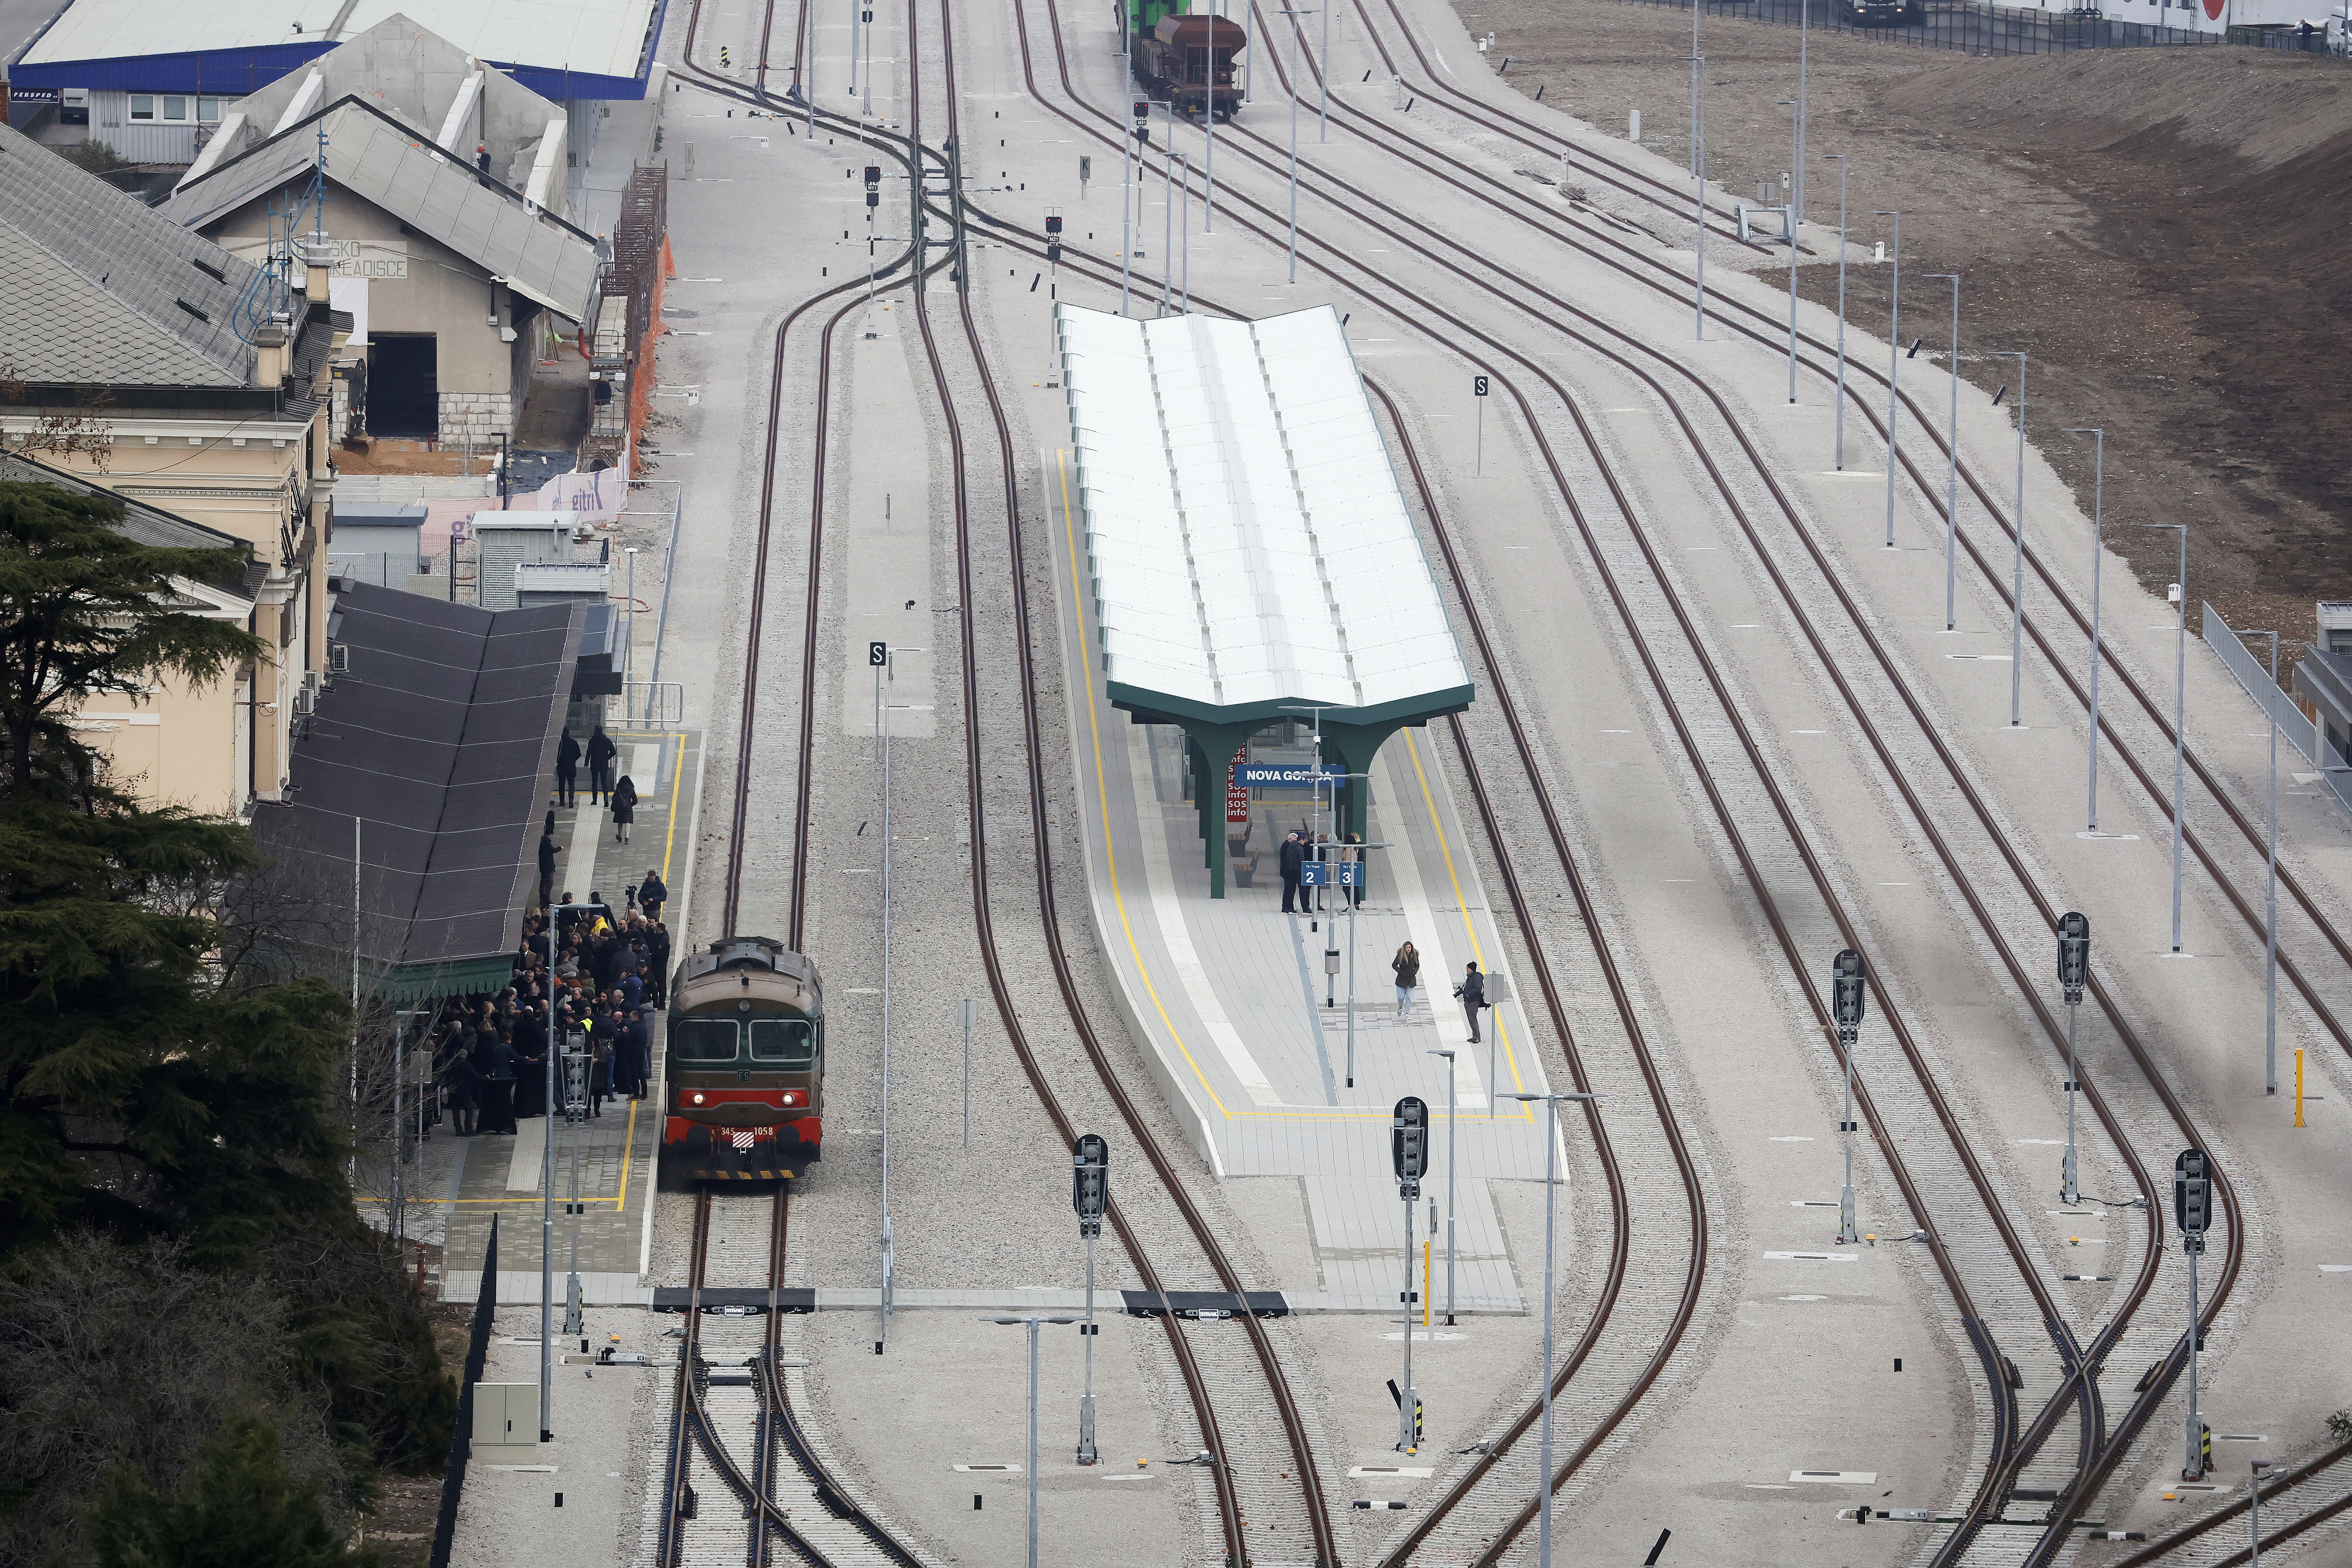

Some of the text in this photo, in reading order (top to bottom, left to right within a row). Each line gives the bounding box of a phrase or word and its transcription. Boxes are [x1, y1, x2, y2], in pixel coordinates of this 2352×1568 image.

[1082, 159, 1088, 170] K
[1478, 379, 1486, 394] S
[874, 646, 883, 662] S
[1247, 771, 1281, 780] NOVA
[1306, 872, 1314, 883] 2
[1342, 872, 1350, 883] 3
[739, 1072, 748, 1080] FS
